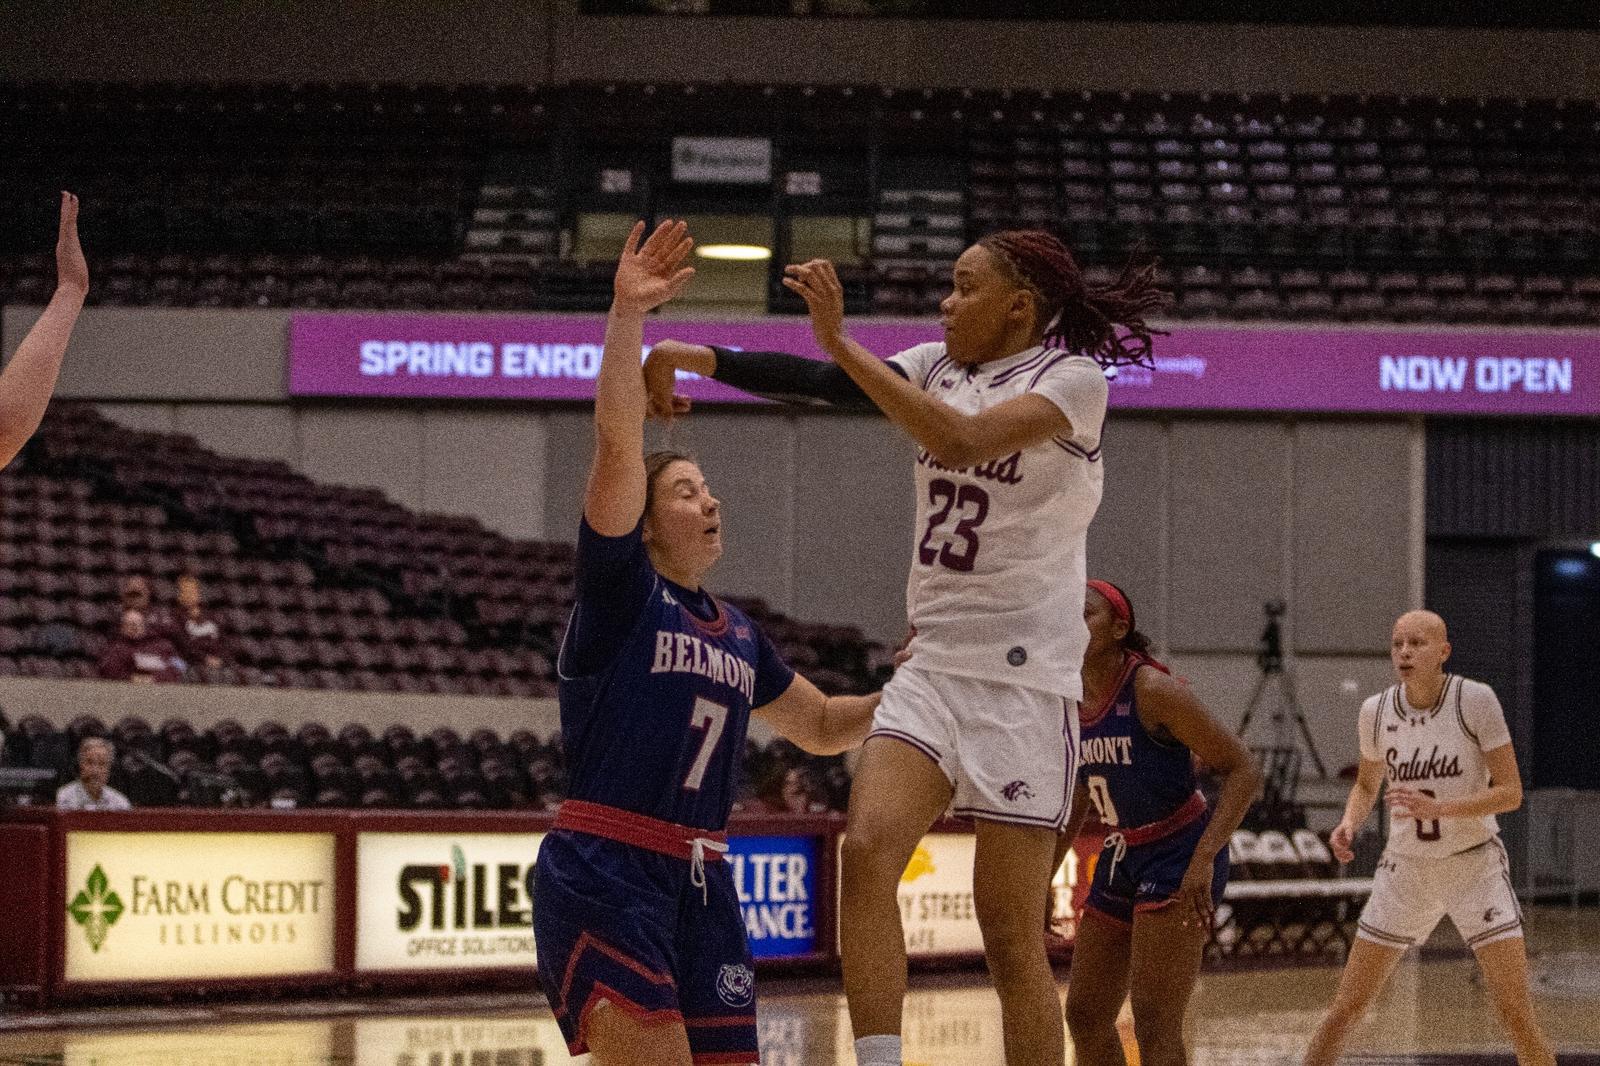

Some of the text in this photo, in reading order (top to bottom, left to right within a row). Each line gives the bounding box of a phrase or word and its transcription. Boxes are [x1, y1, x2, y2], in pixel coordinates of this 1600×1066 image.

[360, 341, 600, 379] SPRING ENRO
[1379, 355, 1572, 393] NOW OPEN
[919, 478, 989, 572] 23
[651, 630, 755, 706] BELMONT
[683, 696, 728, 790] 7
[1079, 736, 1132, 766] MONT
[1385, 746, 1463, 783] Salukis
[131, 874, 324, 915] FARM CREDIT
[919, 893, 974, 921] STREE
[158, 922, 298, 945] ILLINOIS
[741, 902, 809, 940] ANCE
